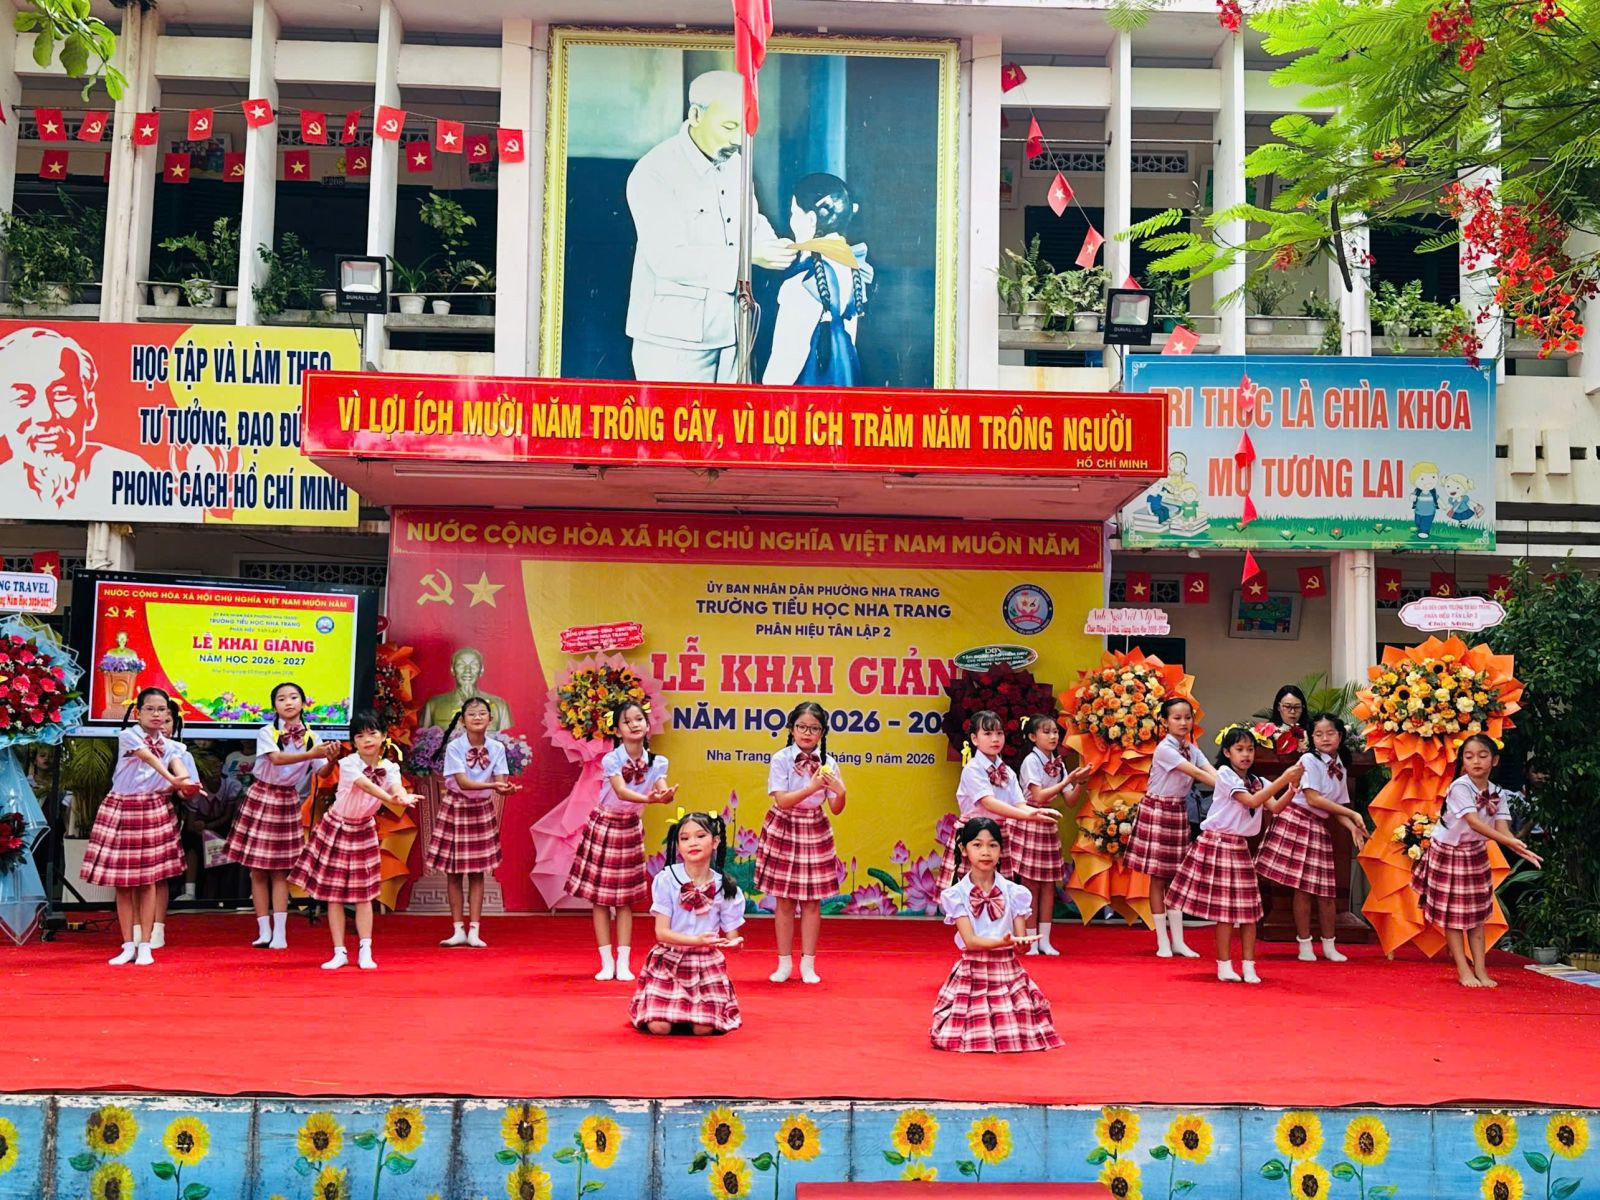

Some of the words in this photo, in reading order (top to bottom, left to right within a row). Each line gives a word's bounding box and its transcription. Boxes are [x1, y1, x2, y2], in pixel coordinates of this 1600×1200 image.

[133, 346, 168, 389] HỌC
[174, 341, 207, 389] TẬP
[214, 341, 236, 383] VÀ
[243, 341, 280, 384] LÀM
[287, 350, 331, 385] THEO
[1151, 388, 1192, 427] RI
[1283, 380, 1314, 428] LÀ
[1324, 380, 1389, 429] CHÌA
[1398, 381, 1471, 430] KHÓA
[140, 407, 163, 444] TƯ
[168, 398, 231, 449] TƯỞNG,
[238, 411, 273, 453] ĐẠO
[338, 390, 360, 431] VÌ
[370, 394, 405, 441] LỢI
[414, 391, 452, 435] ÍCH
[462, 393, 523, 437] MƯỜI
[532, 397, 581, 439] NĂM
[590, 395, 664, 441] TRỒNG
[673, 400, 723, 448] CÂY,
[732, 404, 754, 444] VÌ
[763, 406, 796, 452] LỢI
[805, 404, 843, 446] ÍCH
[852, 406, 913, 448] TRĂM
[922, 407, 970, 449] NĂM
[979, 405, 1052, 451] TRỒNG
[1063, 409, 1132, 452] NGƯỜI
[1097, 455, 1116, 469] CHÍ
[1119, 459, 1148, 469] MINH
[1262, 455, 1352, 497] TƯƠNG
[1363, 460, 1403, 498] LAI
[112, 471, 172, 506] PHONG
[180, 466, 227, 507] CÁCH
[233, 461, 257, 508] HỒ
[263, 468, 293, 509] CHÍ
[300, 475, 347, 511] MINH
[407, 522, 477, 543] NƯỚC
[484, 521, 557, 549] CỘNG
[564, 523, 614, 546] HÒA
[621, 524, 651, 547] XÃ
[658, 525, 699, 553] HỘI
[706, 525, 752, 549] CHỦ
[761, 528, 833, 551] NGHĨA
[840, 529, 888, 557] VIỆT
[895, 534, 945, 553] NAM
[953, 530, 1020, 555] MUÔN
[1029, 532, 1080, 556] NĂM
[13, 581, 49, 593] TRAVEL
[707, 580, 723, 593] ỦY
[726, 584, 750, 594] BAN
[754, 582, 786, 595] NHÂN
[790, 583, 814, 595] DÂN
[818, 584, 868, 597] PHƯỜNG
[872, 587, 896, 597] NHA
[899, 587, 940, 598] TRANG
[282, 598, 300, 606] NAM
[696, 597, 768, 614] TRƯỜNG
[772, 596, 807, 615] TIỂU
[812, 602, 850, 619] HỌC
[854, 603, 889, 616] NHA
[894, 604, 951, 618] TRANG
[218, 637, 258, 651] KHAI
[264, 636, 314, 653] GIẢNG
[756, 622, 791, 635] PHÂN
[795, 622, 824, 639] HIỆU
[828, 623, 852, 636] TÂN
[857, 624, 880, 640] LẬP
[884, 626, 891, 637] 2
[252, 656, 275, 664] 2026
[652, 636, 704, 691] LỄ
[721, 654, 833, 694] KHAI
[850, 648, 956, 695] GIẢN
[674, 702, 736, 730] NĂM
[745, 708, 786, 737] HỌ
[831, 709, 880, 732] 026
[909, 712, 942, 733] 20
[707, 750, 731, 761] Nha
[735, 750, 771, 764] Trang
[828, 752, 861, 766] háng
[865, 752, 872, 763] 9
[876, 752, 902, 764] năm
[907, 754, 935, 764] 2026
